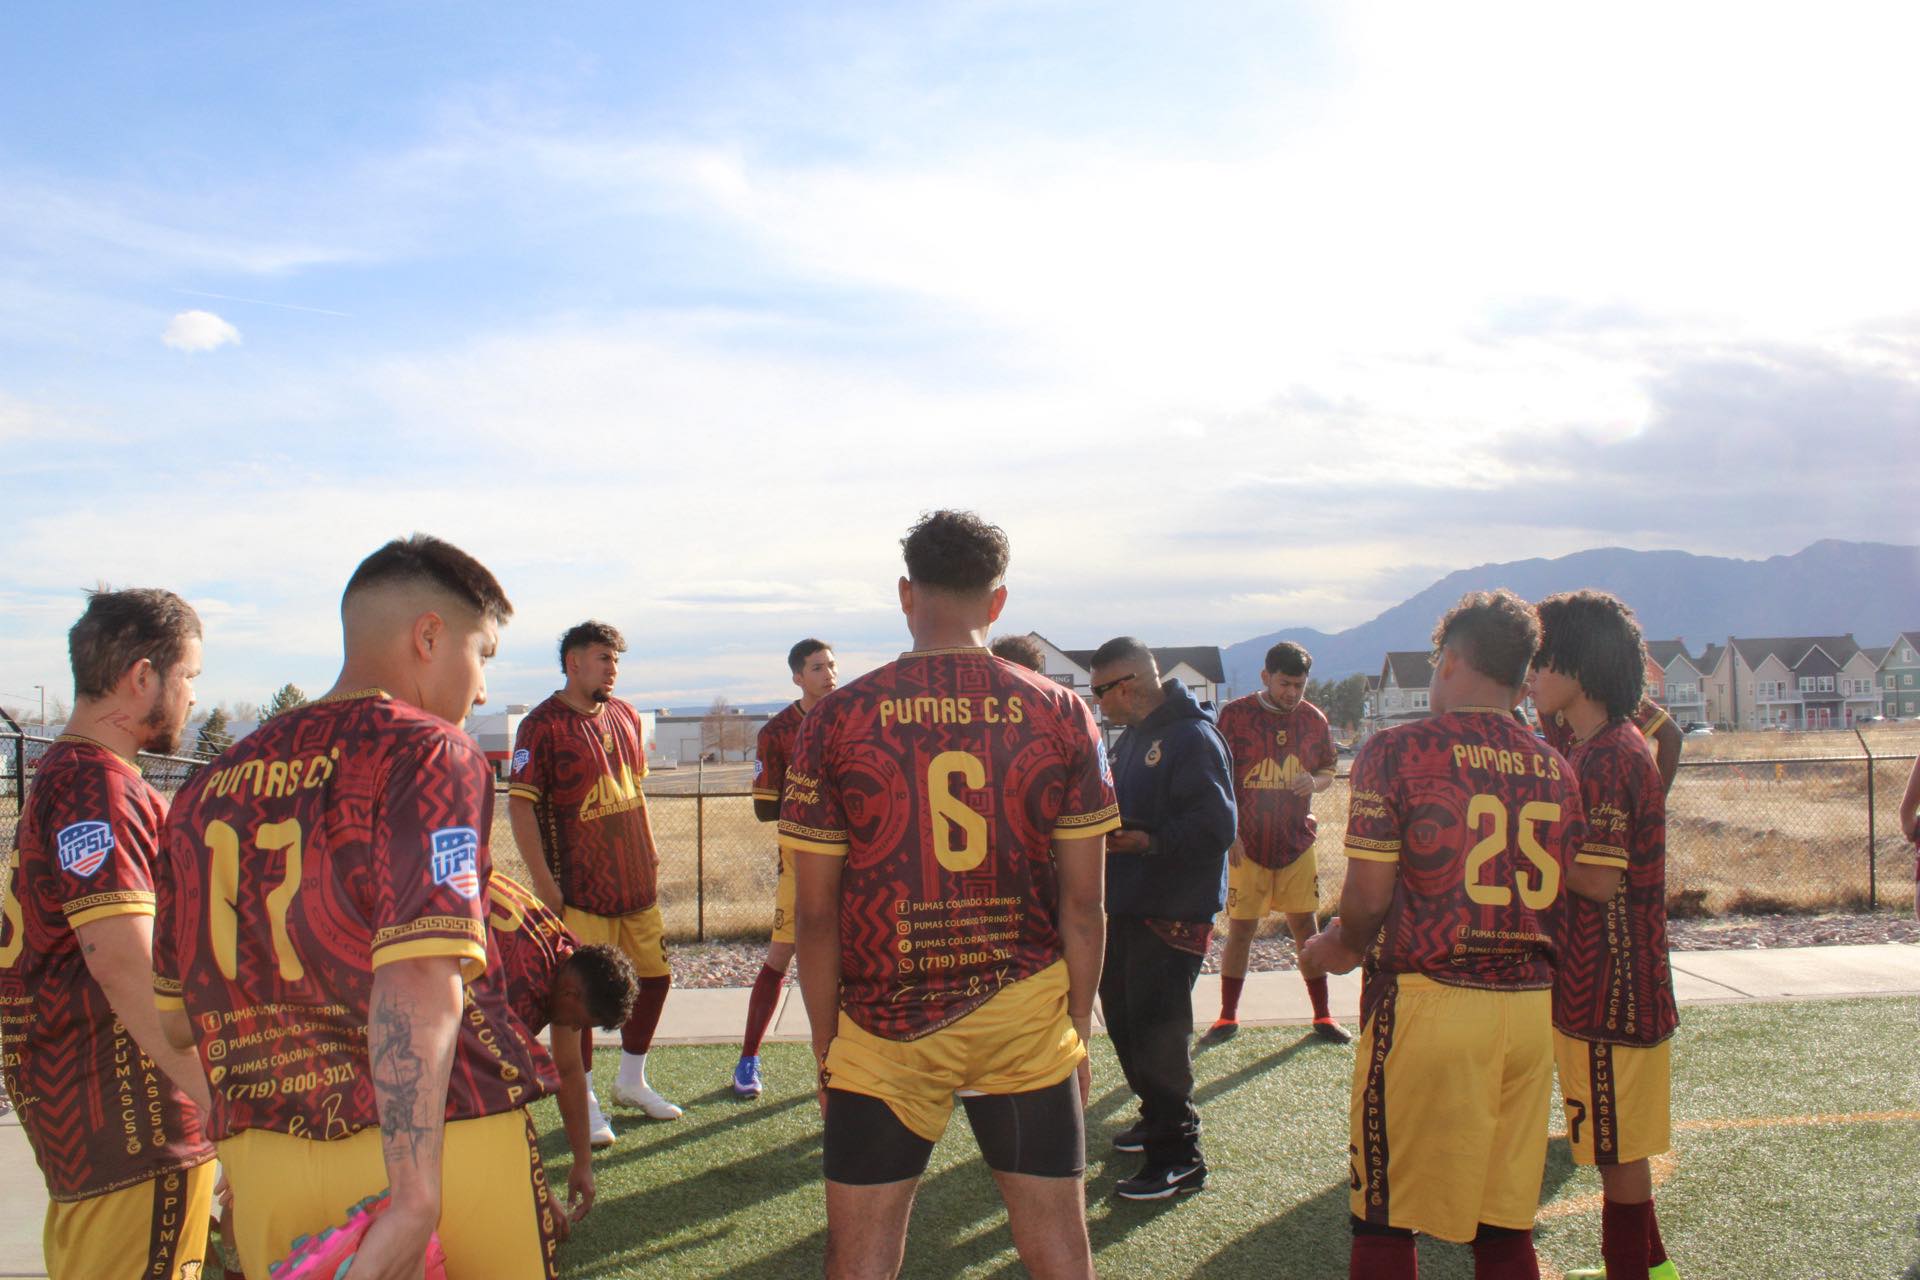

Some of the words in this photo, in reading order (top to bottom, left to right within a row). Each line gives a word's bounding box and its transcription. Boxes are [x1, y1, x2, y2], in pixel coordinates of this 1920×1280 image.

[880, 697, 972, 727] PUMAS
[983, 696, 1023, 723] C.S
[1243, 754, 1307, 784] PUMA
[1453, 744, 1525, 775] PUMAS
[1533, 754, 1561, 781] C.S
[201, 759, 303, 802] PUMAS
[927, 751, 988, 872] 6
[60, 829, 114, 867] UPSL
[1465, 794, 1561, 910] 25
[204, 818, 304, 981] 17
[913, 901, 944, 912] PUMAS
[984, 896, 1022, 906] SPRINGS
[914, 920, 943, 930] PUMAS
[979, 915, 1013, 924] SPRINGS
[1471, 929, 1496, 938] PUMAS
[915, 938, 946, 949] PUMAS
[919, 954, 956, 971] (719)
[224, 1008, 257, 1024] PUMAS
[229, 1032, 263, 1050] PUMAS
[226, 1079, 277, 1101] (719)
[281, 1062, 355, 1094] 800-3121
[231, 1059, 268, 1075] PUMAS
